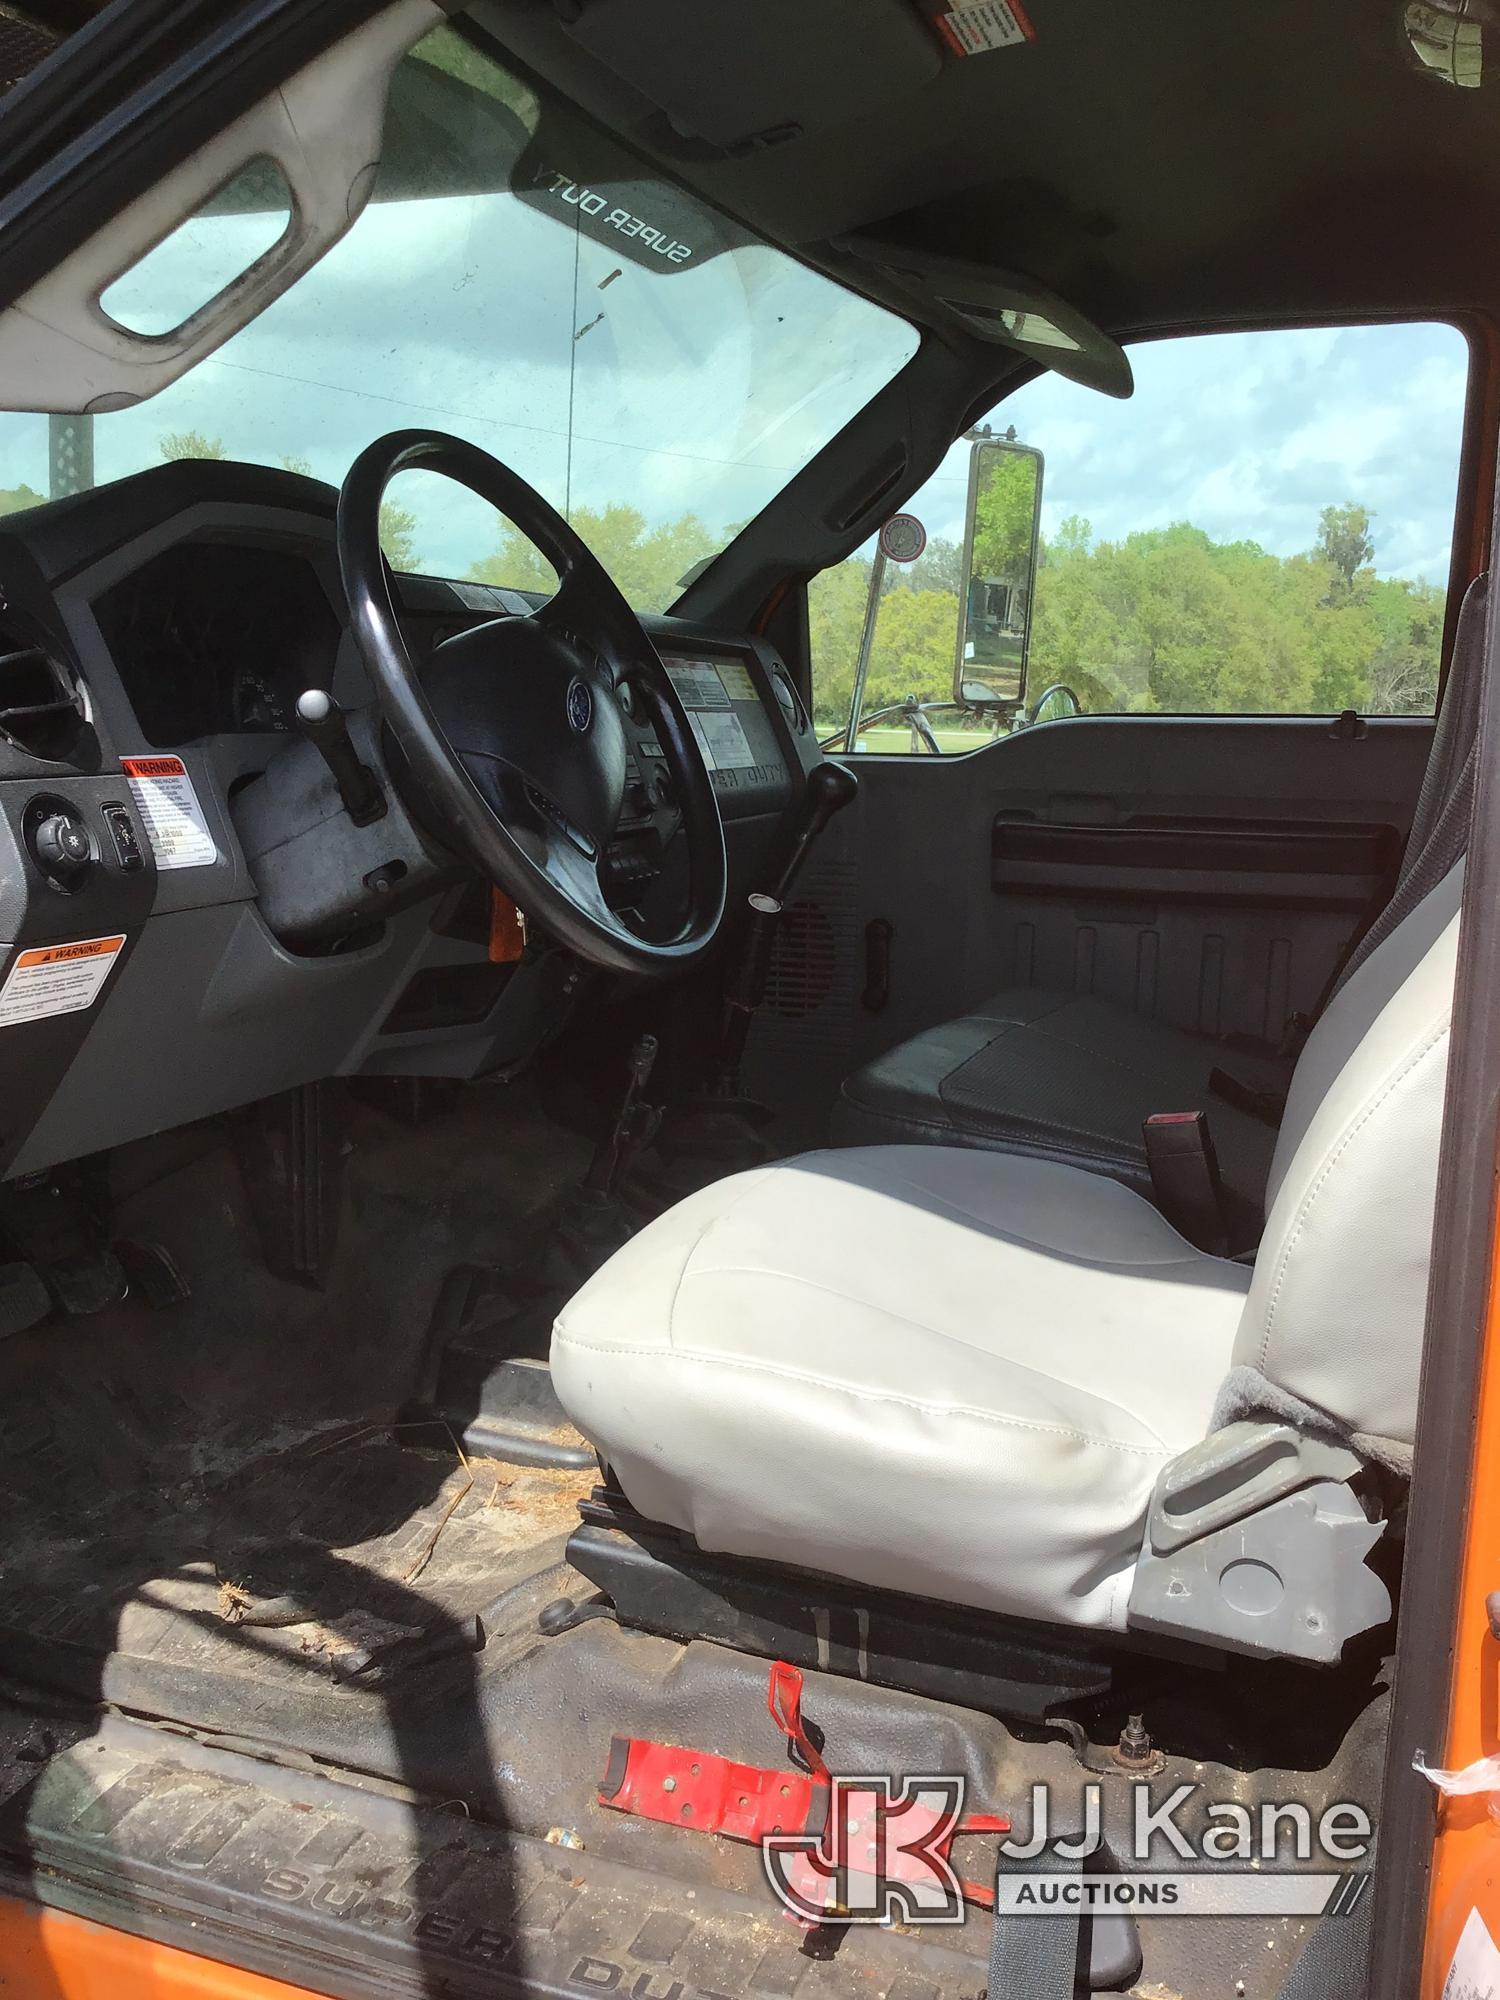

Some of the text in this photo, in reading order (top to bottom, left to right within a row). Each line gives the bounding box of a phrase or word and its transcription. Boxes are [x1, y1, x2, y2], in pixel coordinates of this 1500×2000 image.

[134, 760, 182, 775] WARNING
[55, 943, 102, 959] WARNING
[261, 1868, 740, 2000] SUPER DU
